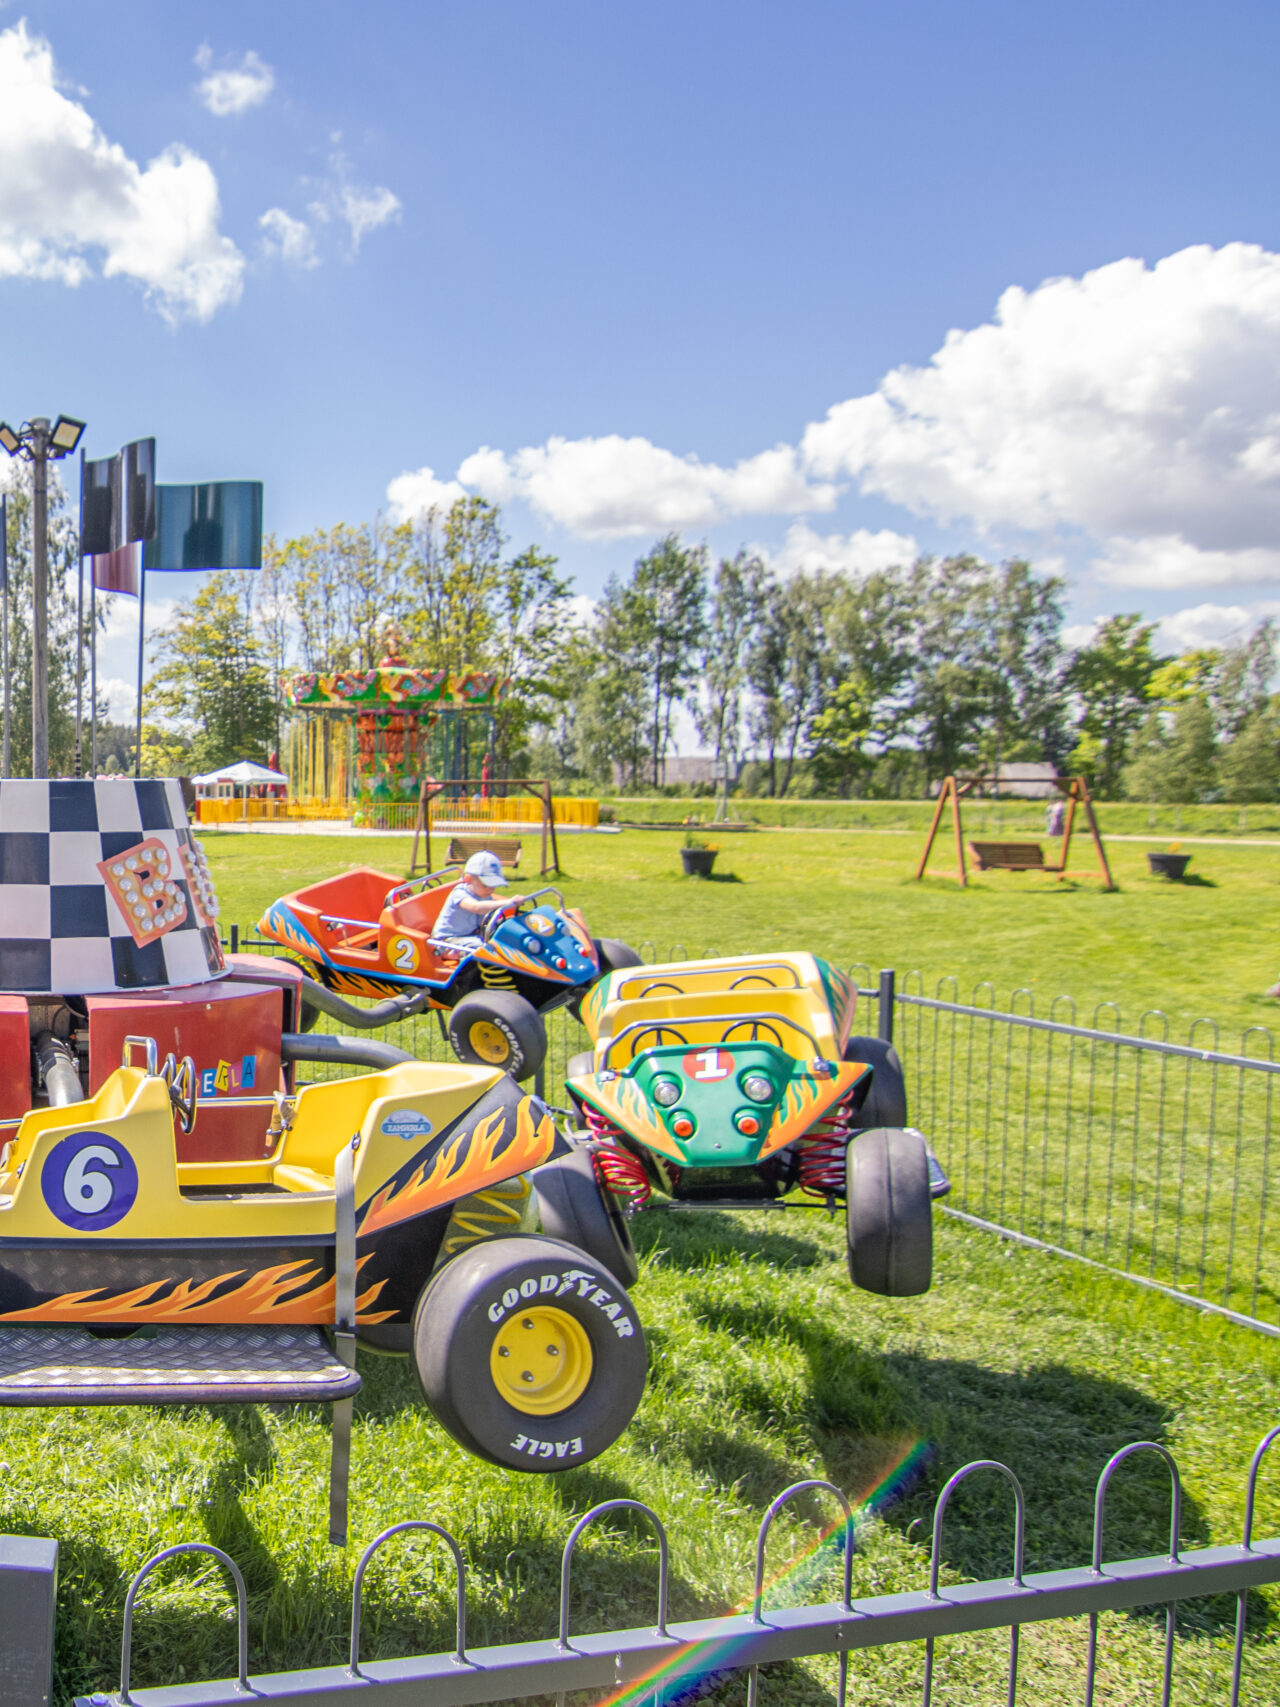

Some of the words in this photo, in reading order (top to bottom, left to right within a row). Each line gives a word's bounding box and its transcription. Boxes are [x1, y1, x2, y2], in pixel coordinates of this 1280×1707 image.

[528, 914, 551, 933] 2
[395, 939, 414, 969] 2
[695, 1047, 728, 1079] 1
[62, 1144, 123, 1215] 6
[488, 1269, 636, 1338] GOODYEAR
[509, 1433, 584, 1458] EAGLE
